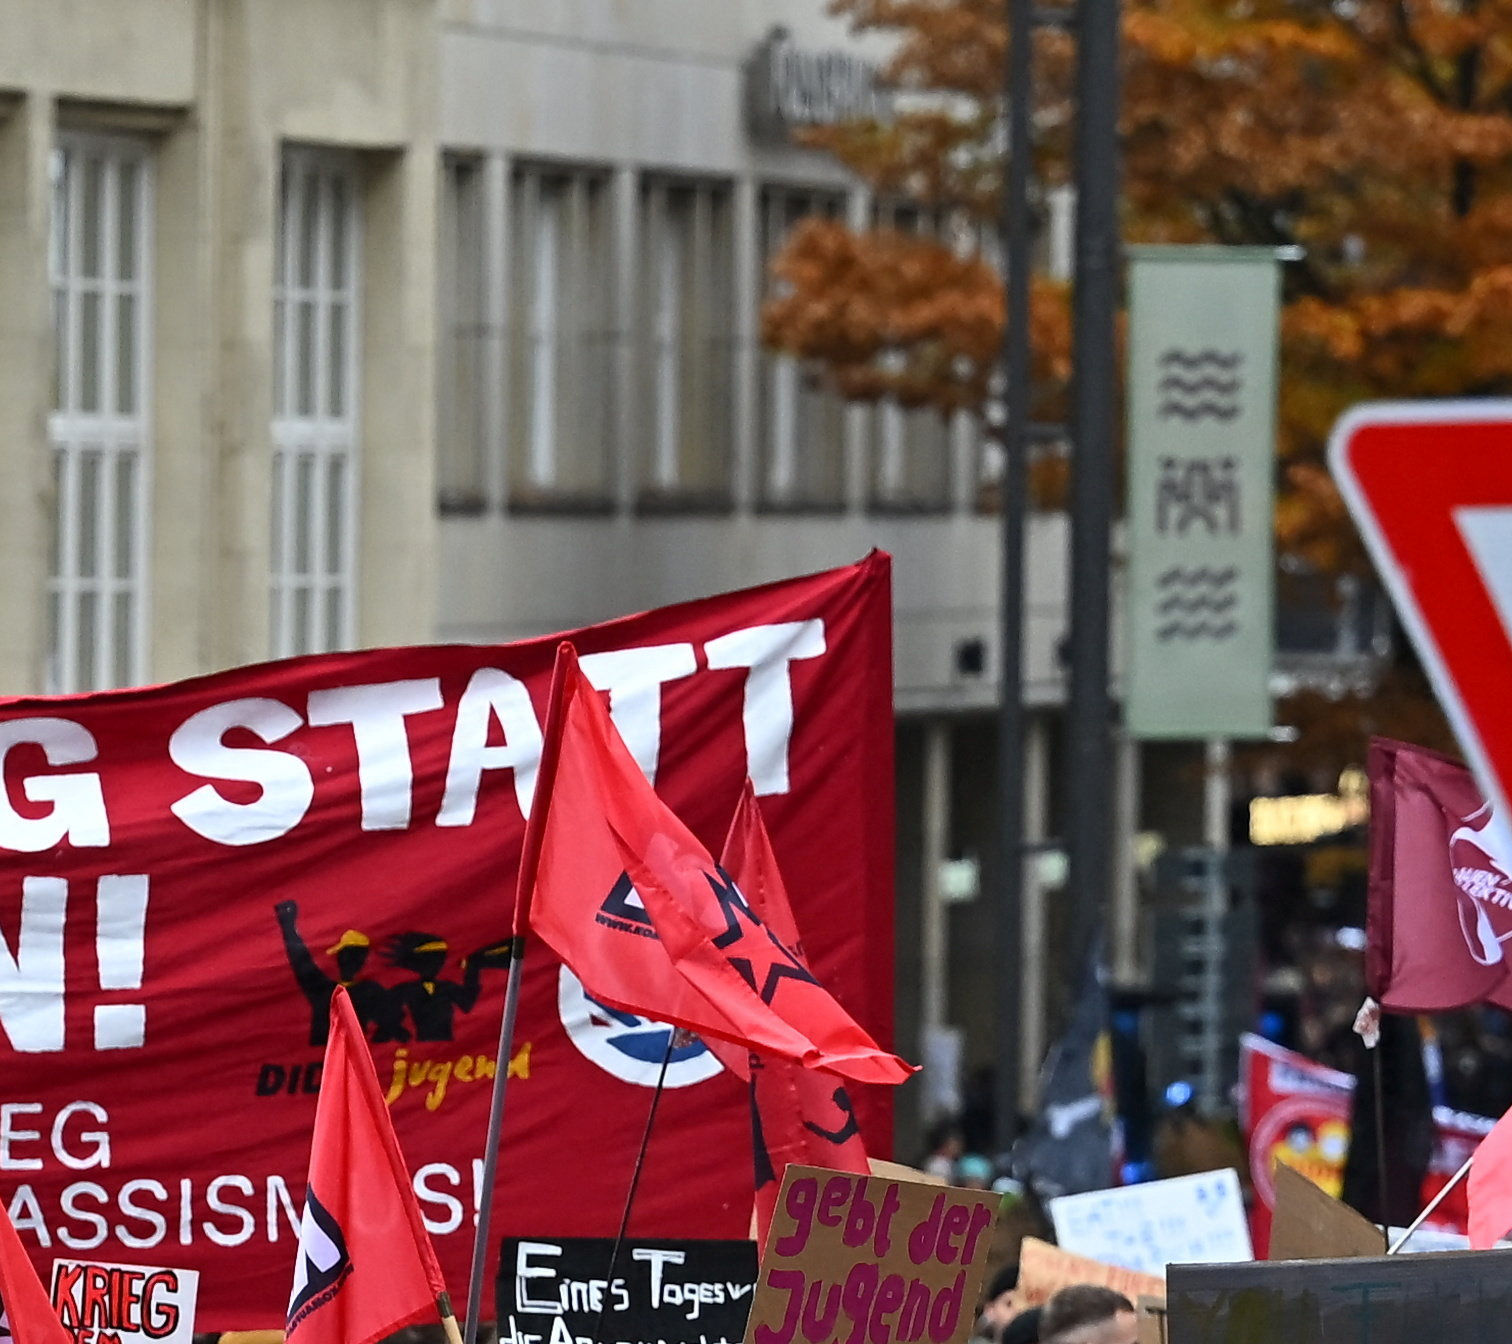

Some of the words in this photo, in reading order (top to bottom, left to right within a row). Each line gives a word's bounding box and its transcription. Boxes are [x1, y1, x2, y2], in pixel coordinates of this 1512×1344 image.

[167, 618, 826, 847] STATT
[384, 1042, 532, 1112] jugend
[774, 1174, 901, 1258] gebt
[908, 1191, 993, 1266] der
[52, 1263, 180, 1340] KRIEG
